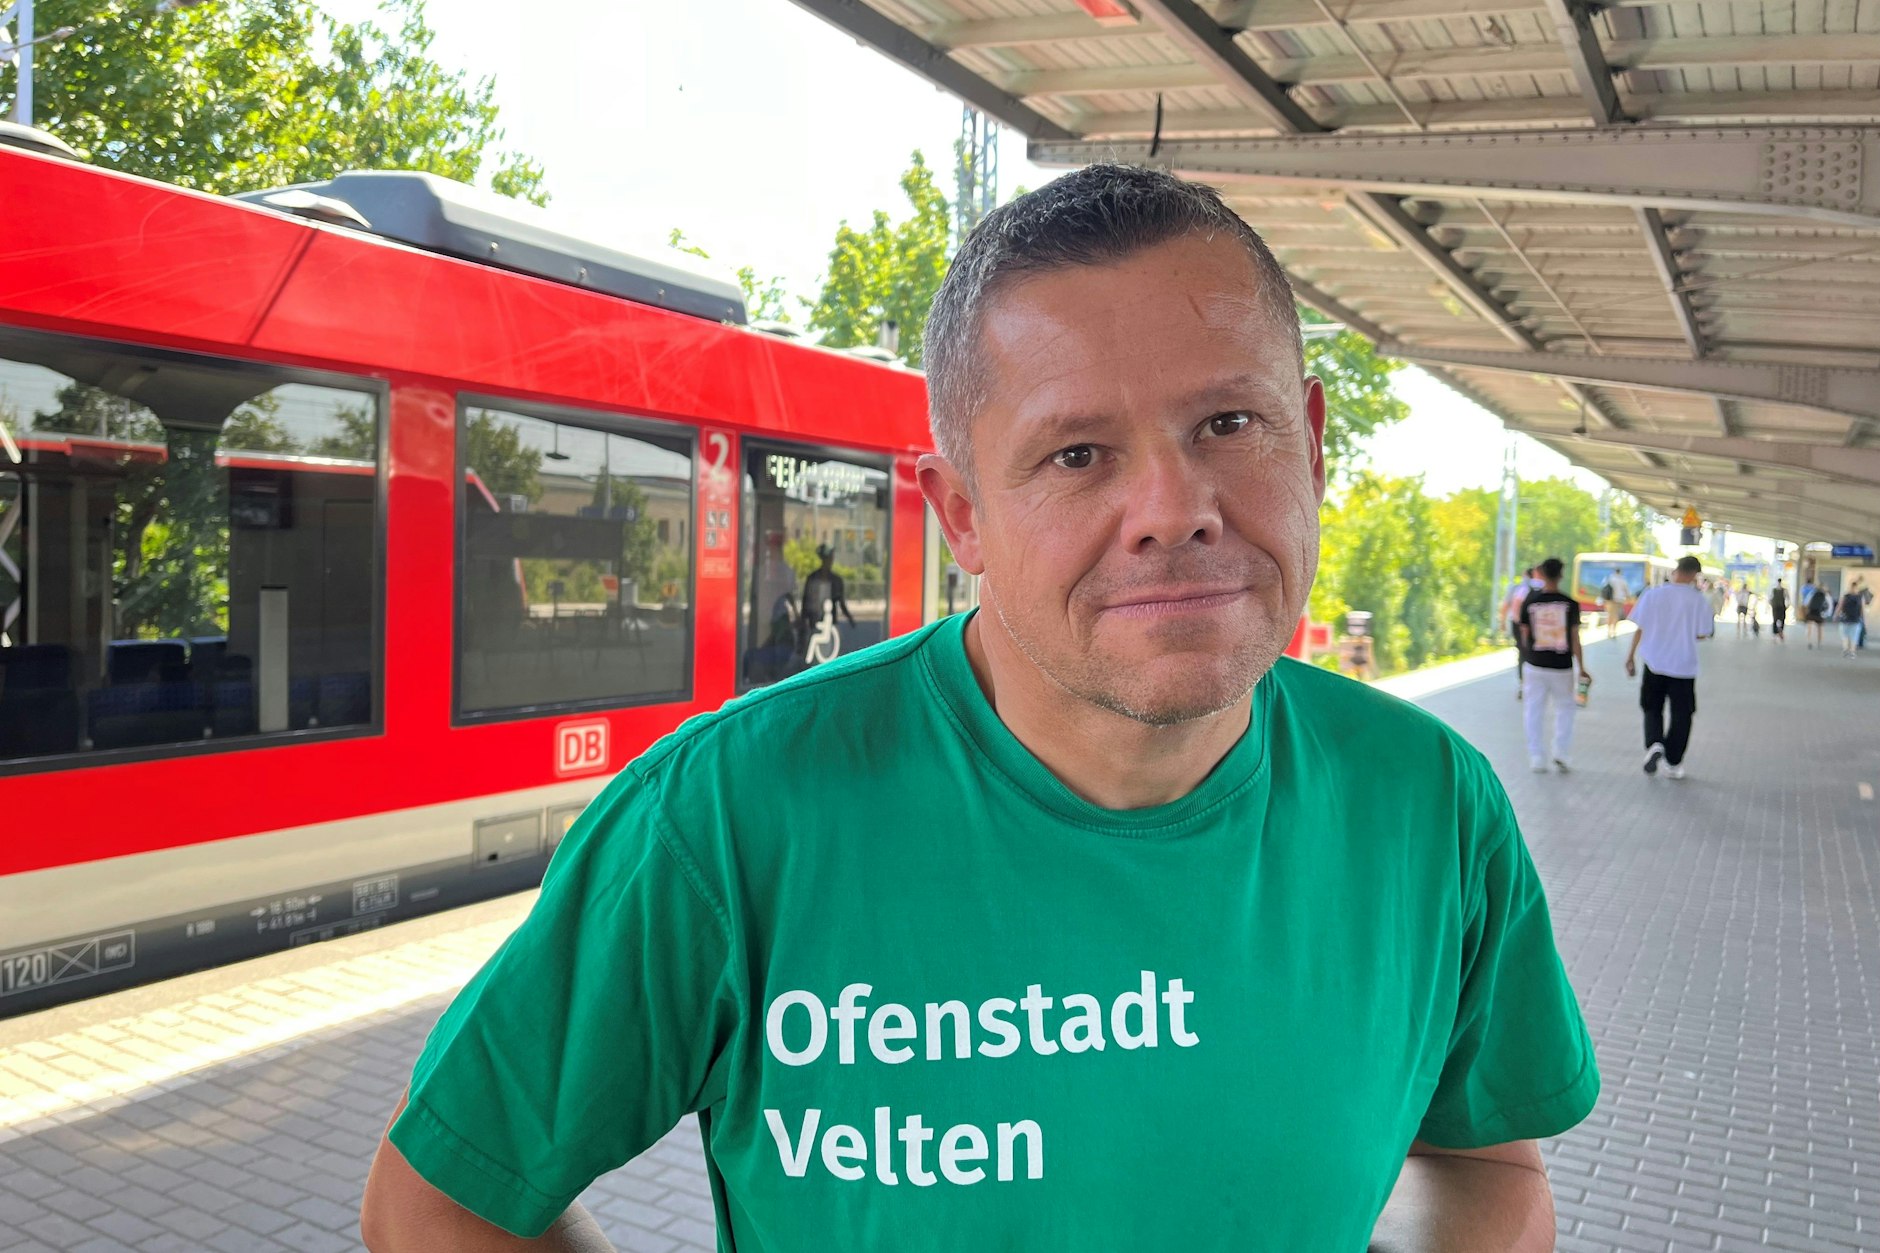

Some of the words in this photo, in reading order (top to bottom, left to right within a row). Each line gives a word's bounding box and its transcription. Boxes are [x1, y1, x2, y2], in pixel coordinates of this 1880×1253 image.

[709, 432, 730, 482] 2
[564, 731, 602, 765] DB
[3, 953, 47, 989] 120
[765, 970, 1200, 1066] Ofenstadt
[763, 1106, 1044, 1187] Velten
